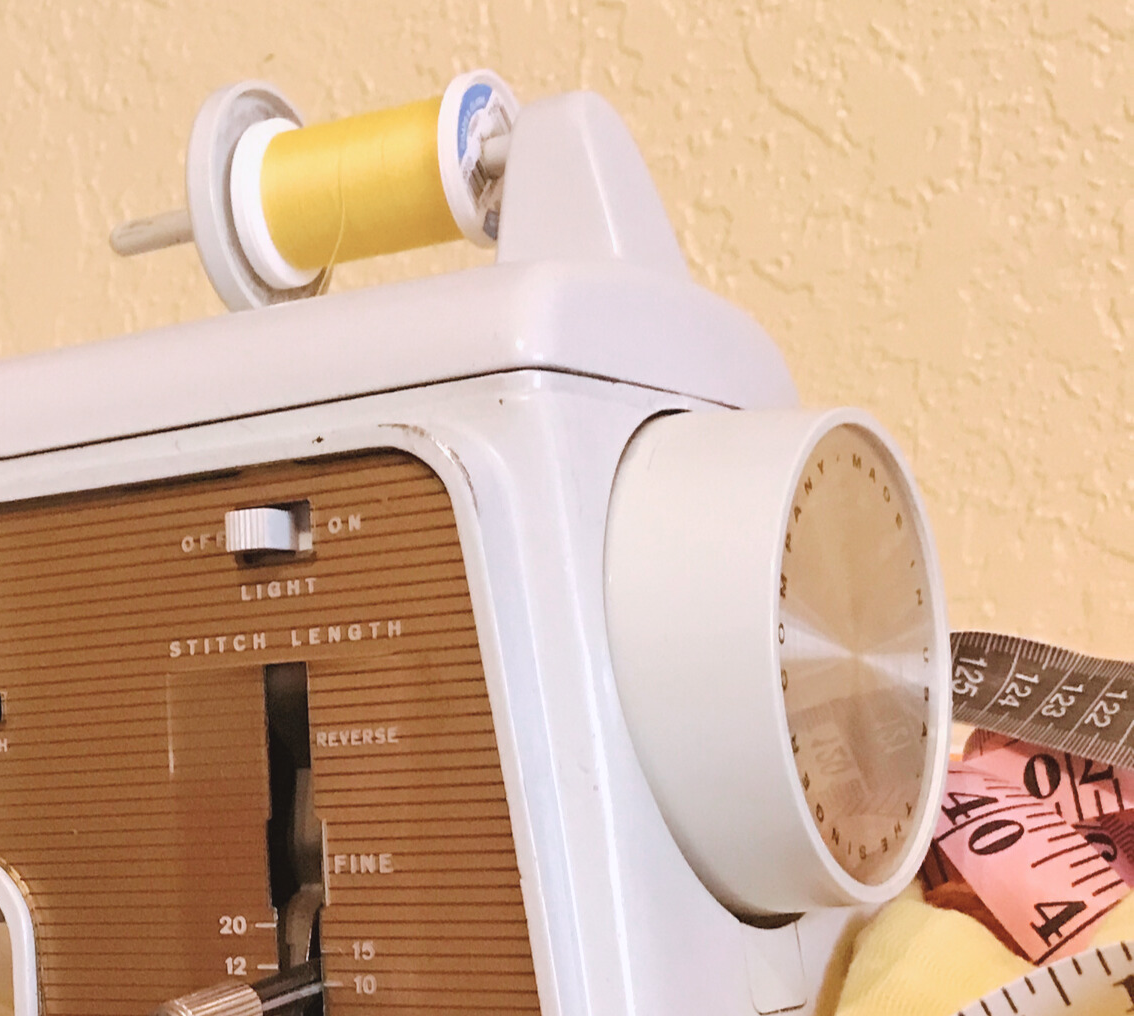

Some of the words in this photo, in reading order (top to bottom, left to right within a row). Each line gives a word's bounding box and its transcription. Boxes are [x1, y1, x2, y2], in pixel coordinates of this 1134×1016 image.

[328, 514, 363, 533] ON
[241, 577, 317, 601] LIGHT
[169, 632, 267, 658] STITCH
[291, 620, 402, 648] LENGTH
[998, 673, 1039, 708] 124
[1042, 683, 1084, 718] 123
[1084, 690, 1128, 728] 122
[316, 726, 400, 748] REVERSE
[334, 853, 394, 875] FINE
[219, 915, 247, 935] 20
[352, 941, 376, 960] 15
[224, 957, 247, 975] 12
[353, 975, 377, 995] 10
